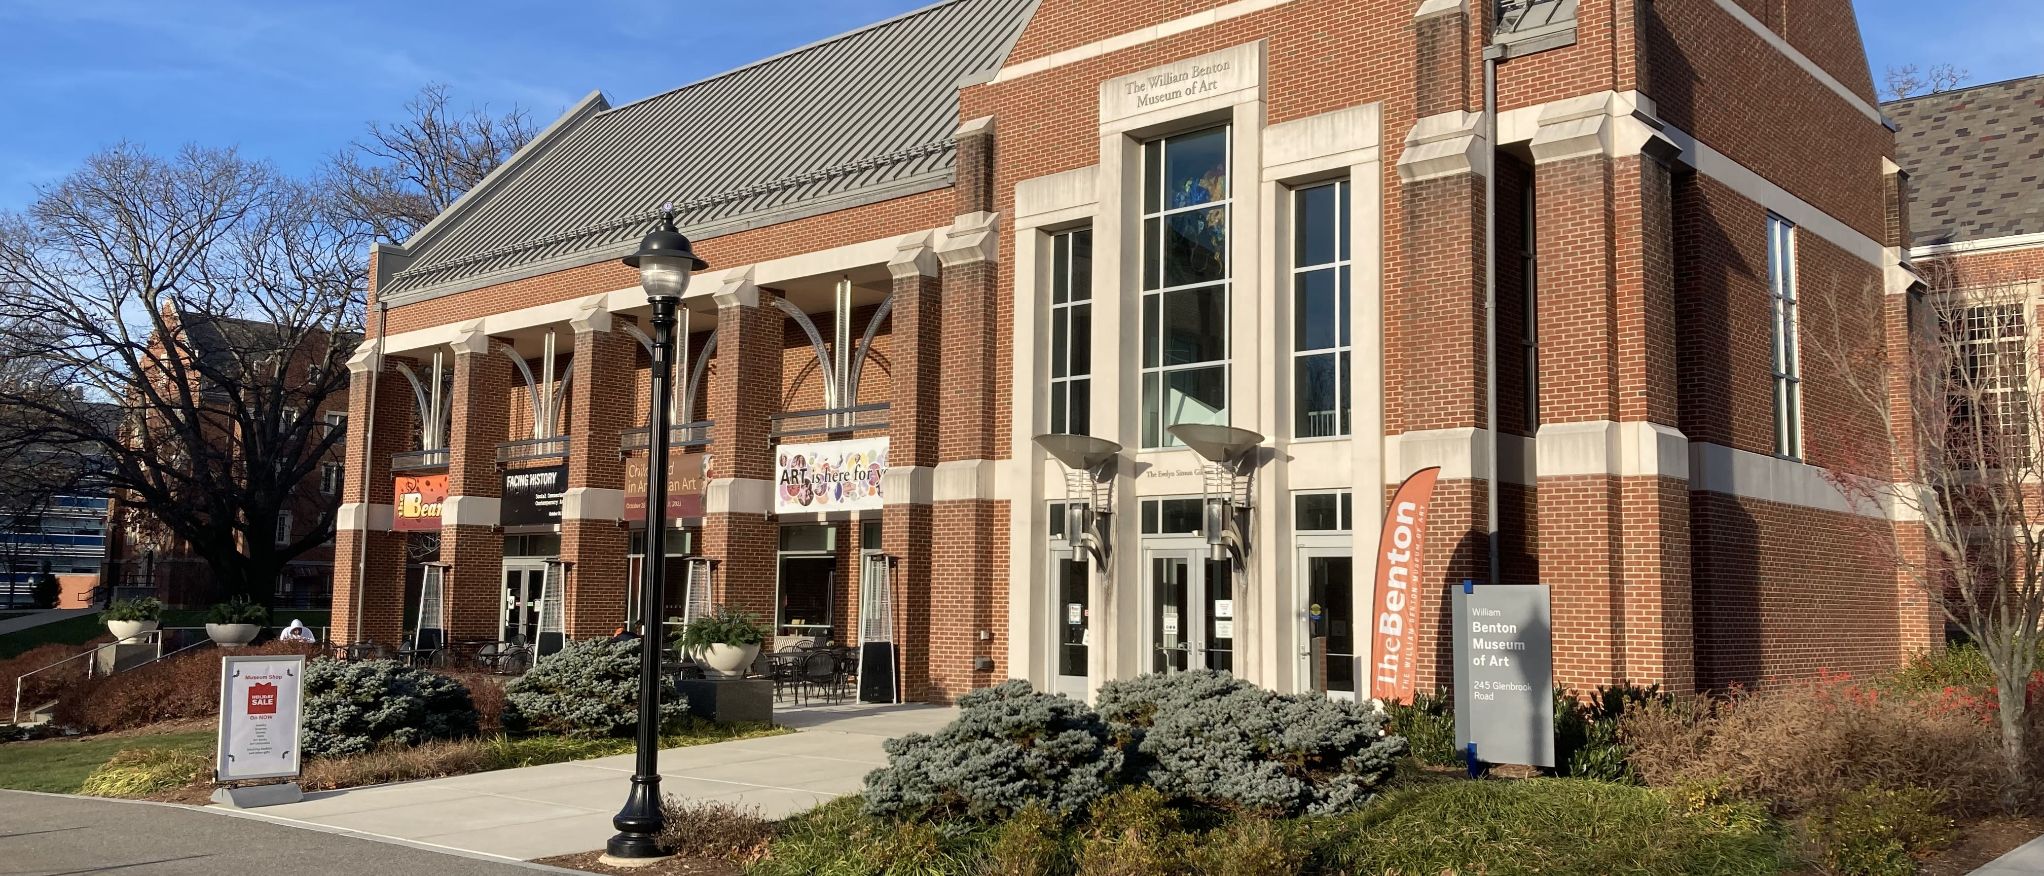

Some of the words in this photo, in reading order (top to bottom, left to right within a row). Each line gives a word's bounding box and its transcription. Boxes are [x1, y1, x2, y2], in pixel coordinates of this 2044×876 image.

[1125, 82, 1145, 95] The
[1146, 72, 1189, 90] William
[1191, 61, 1230, 78] Benton
[1137, 91, 1182, 108] Museum
[1185, 81, 1197, 96] of
[1198, 79, 1218, 94] Art
[507, 474, 530, 488] FACING
[530, 472, 557, 486] HISTORY
[780, 468, 808, 485] ART
[812, 469, 821, 484] is
[824, 466, 850, 483] here
[854, 463, 872, 481] for
[628, 480, 637, 493] in
[682, 477, 697, 490] Art
[1418, 505, 1426, 524] ART
[1416, 527, 1423, 539] OF
[1412, 544, 1420, 582] MUSEUM
[1408, 587, 1418, 624] BENTON
[1472, 607, 1501, 617] William
[1472, 621, 1517, 634] Benton
[1404, 627, 1415, 668] WILLIAM
[1473, 638, 1526, 650] Museum
[1473, 654, 1486, 666] of
[1489, 655, 1509, 667] Art
[1402, 672, 1410, 690] THE
[1473, 681, 1491, 690] 245
[1492, 681, 1532, 692] Glenbrook
[1474, 691, 1494, 701] Road
